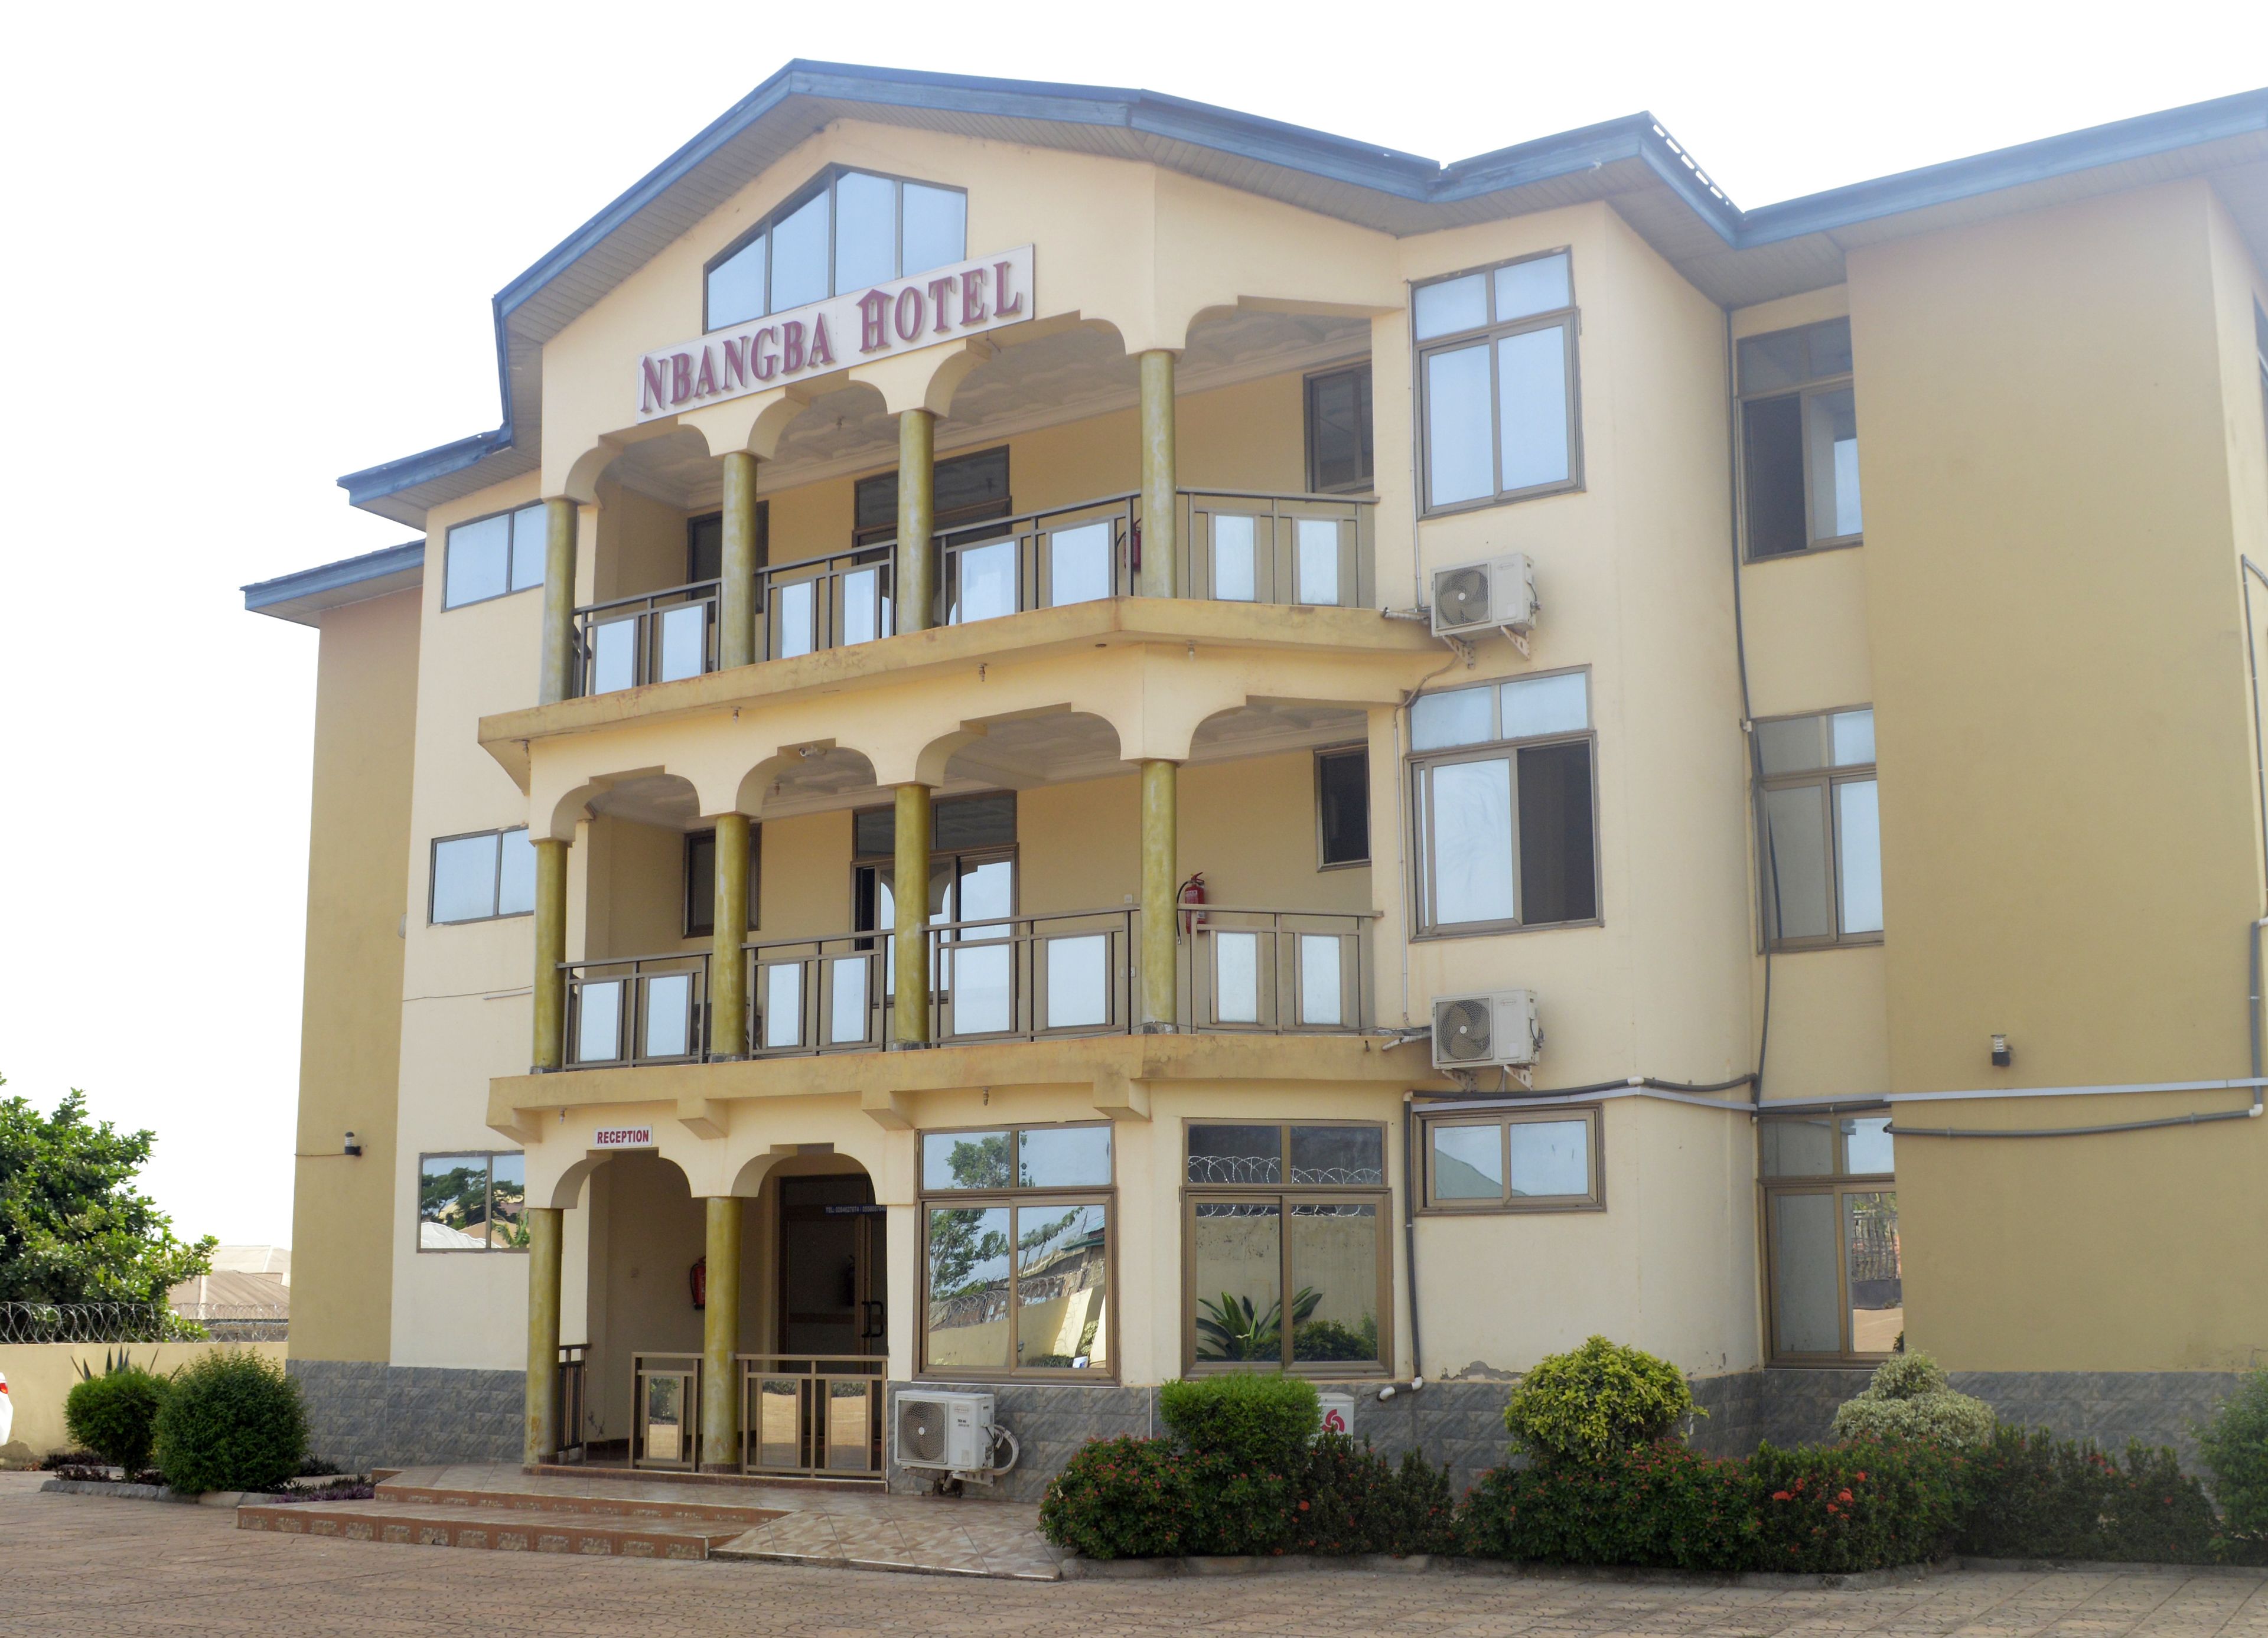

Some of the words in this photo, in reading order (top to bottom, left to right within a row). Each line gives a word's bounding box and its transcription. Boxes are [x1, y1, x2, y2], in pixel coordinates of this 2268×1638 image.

[640, 312, 834, 413] NBANGBA
[856, 260, 1022, 353] HOTEL
[597, 1130, 649, 1144] RECEPTION
